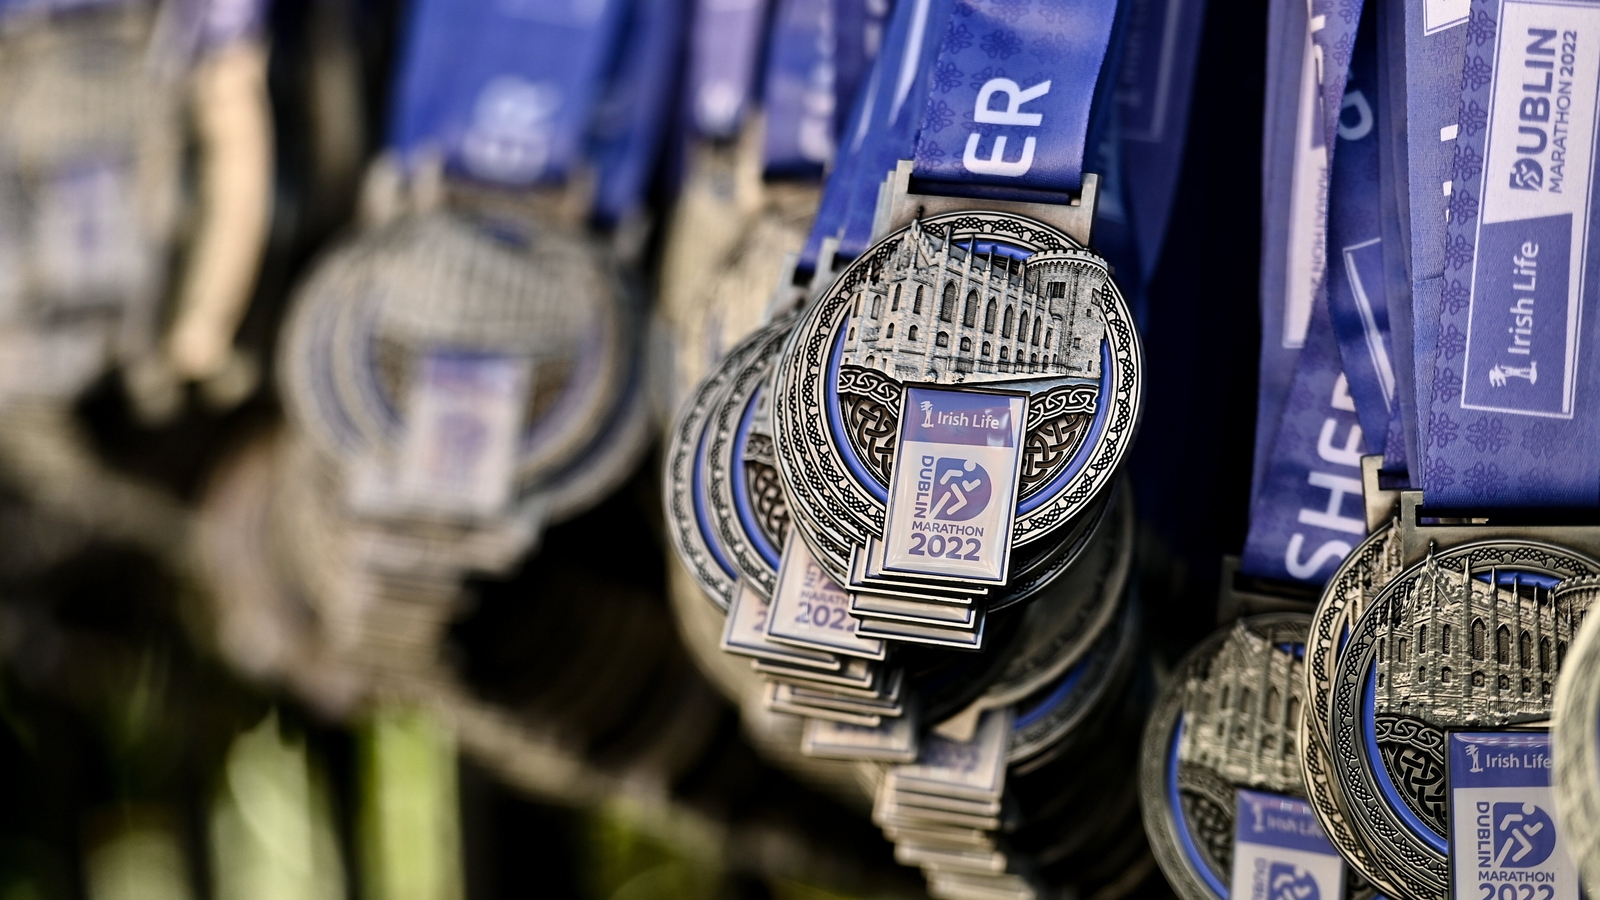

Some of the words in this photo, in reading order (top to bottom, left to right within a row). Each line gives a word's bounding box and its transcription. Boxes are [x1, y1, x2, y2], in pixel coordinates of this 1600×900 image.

[1560, 30, 1577, 78] 2022
[963, 77, 1051, 177] ER
[1509, 28, 1557, 192] DUBLIN
[1549, 81, 1572, 194] MARATHON
[1513, 241, 1539, 292] Life
[1507, 298, 1534, 355] Irish
[937, 411, 969, 428] Irish
[972, 413, 1000, 430] Life
[913, 455, 935, 519] DUBLIN
[908, 532, 982, 562] 2022
[911, 520, 984, 537] MARATHON
[1486, 753, 1520, 768] Irish
[1523, 754, 1552, 769] Life
[1476, 801, 1491, 868] DUBLIN
[1478, 870, 1555, 883] MARATHON
[1478, 883, 1555, 900] 2022
